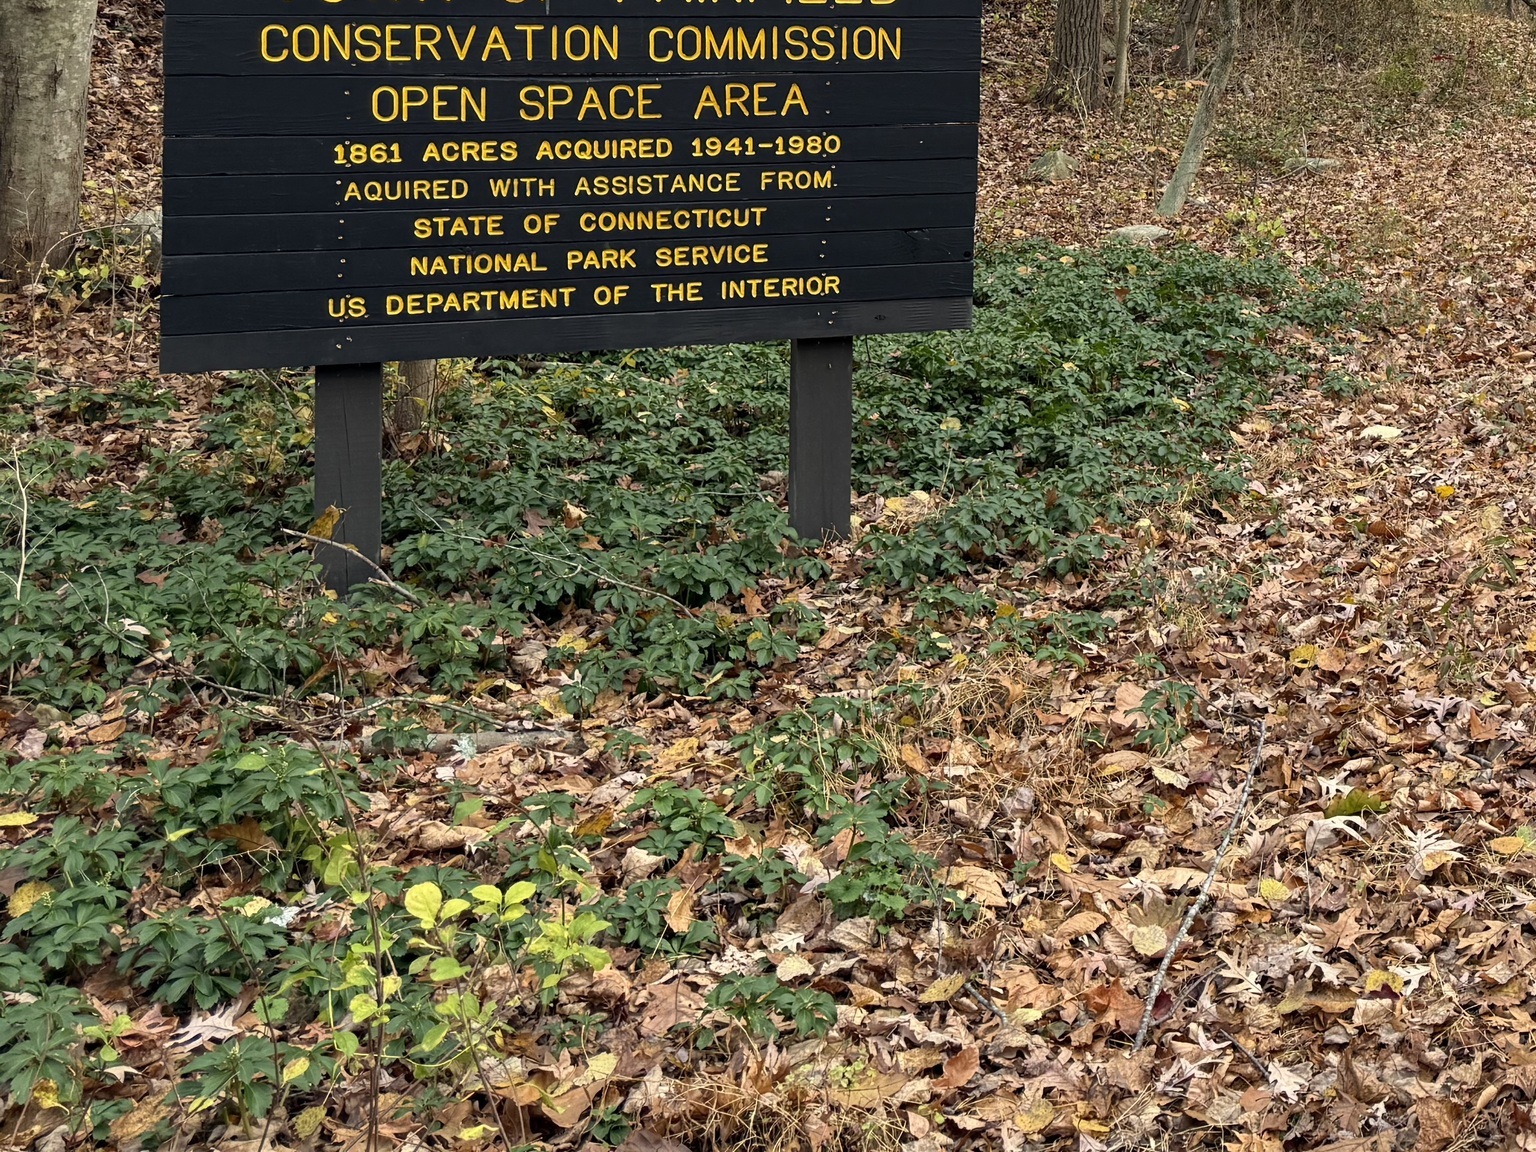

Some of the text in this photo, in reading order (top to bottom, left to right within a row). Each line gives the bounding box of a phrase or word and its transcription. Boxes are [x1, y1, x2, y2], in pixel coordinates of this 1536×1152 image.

[260, 24, 902, 63] CONSERVATION COMMISSION
[371, 82, 809, 122] OPEN SPACE AREA
[334, 134, 841, 165] 1861 ACRES ACQUIRED 1941-1980
[344, 170, 832, 202] AQUIRED WITH ASSISTANCE FROM
[414, 207, 767, 239] STATE OF CONNECTICUT
[410, 243, 768, 276] NATIONAL PARK SERVICE
[328, 275, 841, 318] US DEPARTMENT OF THE INTERIOR
